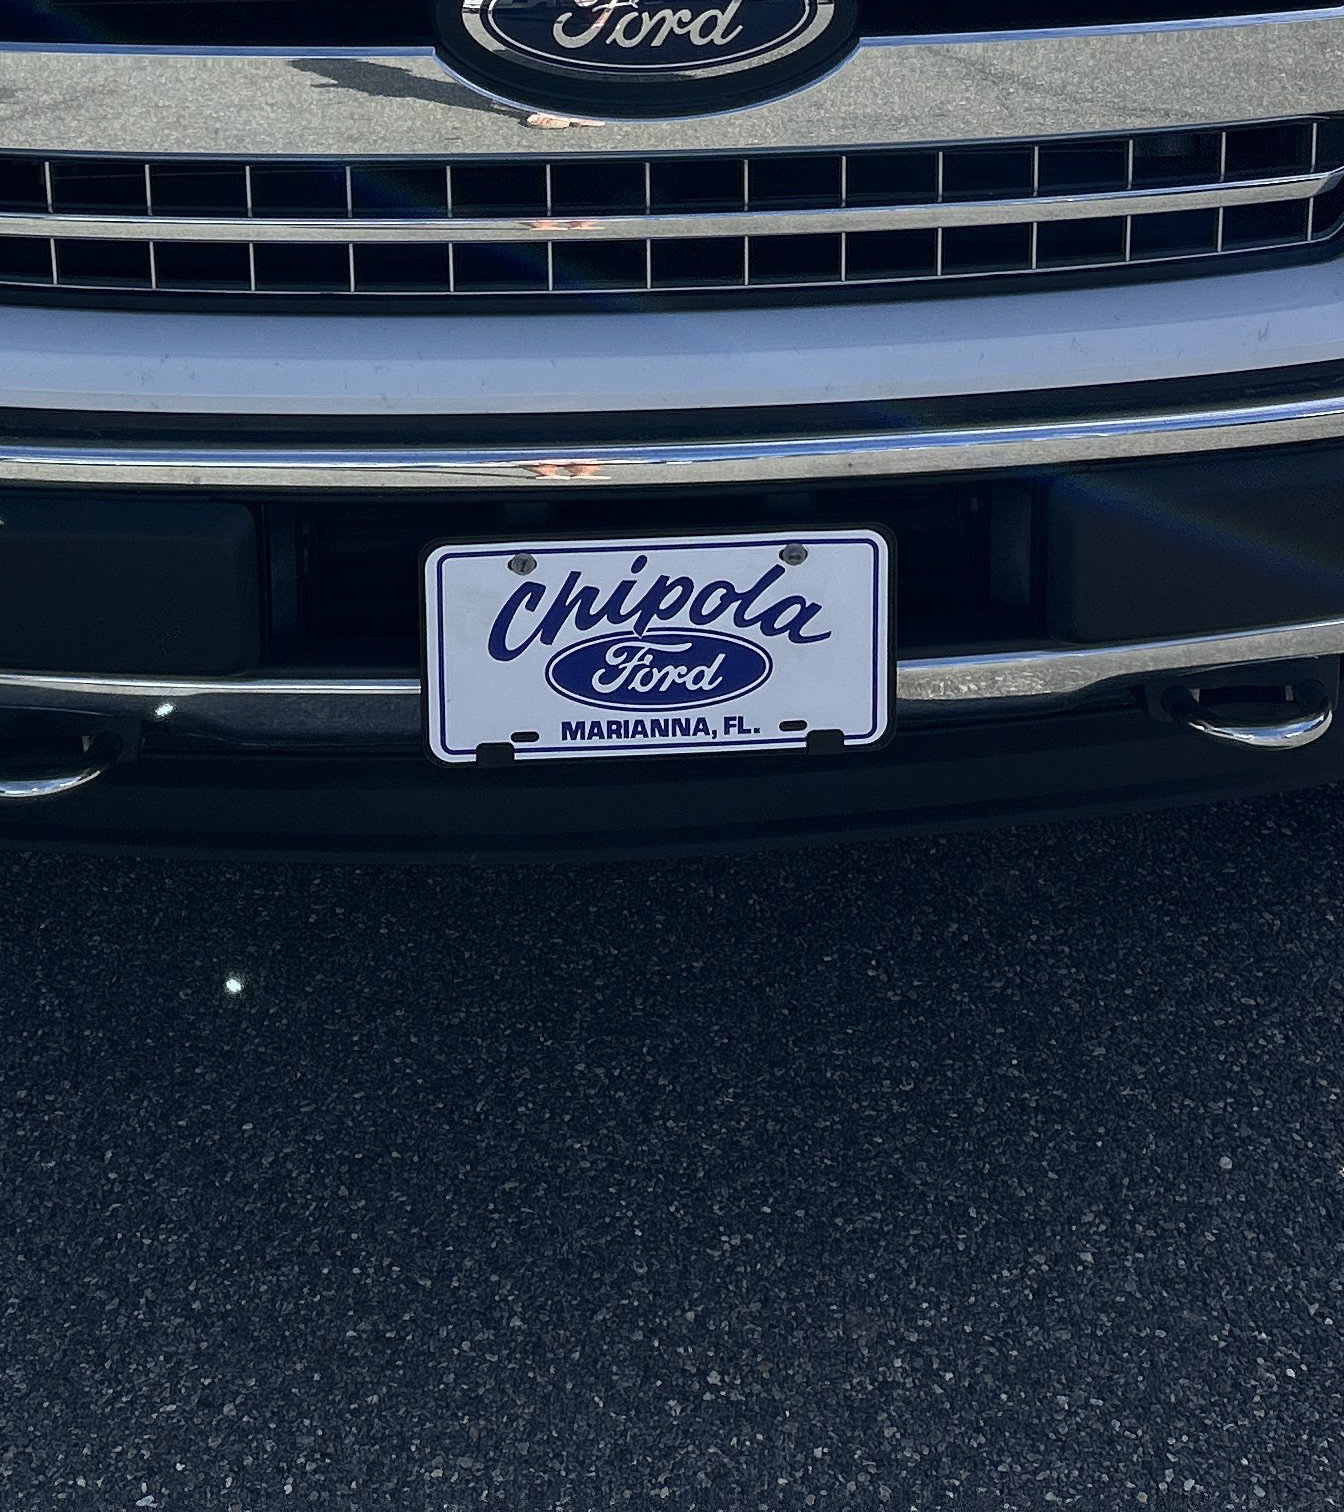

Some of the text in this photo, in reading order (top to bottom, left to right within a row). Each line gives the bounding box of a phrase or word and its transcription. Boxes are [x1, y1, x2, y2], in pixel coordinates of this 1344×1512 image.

[488, 554, 832, 662] Chipola
[591, 640, 724, 694] Ford
[561, 715, 761, 741] MARIANNA, FL.
